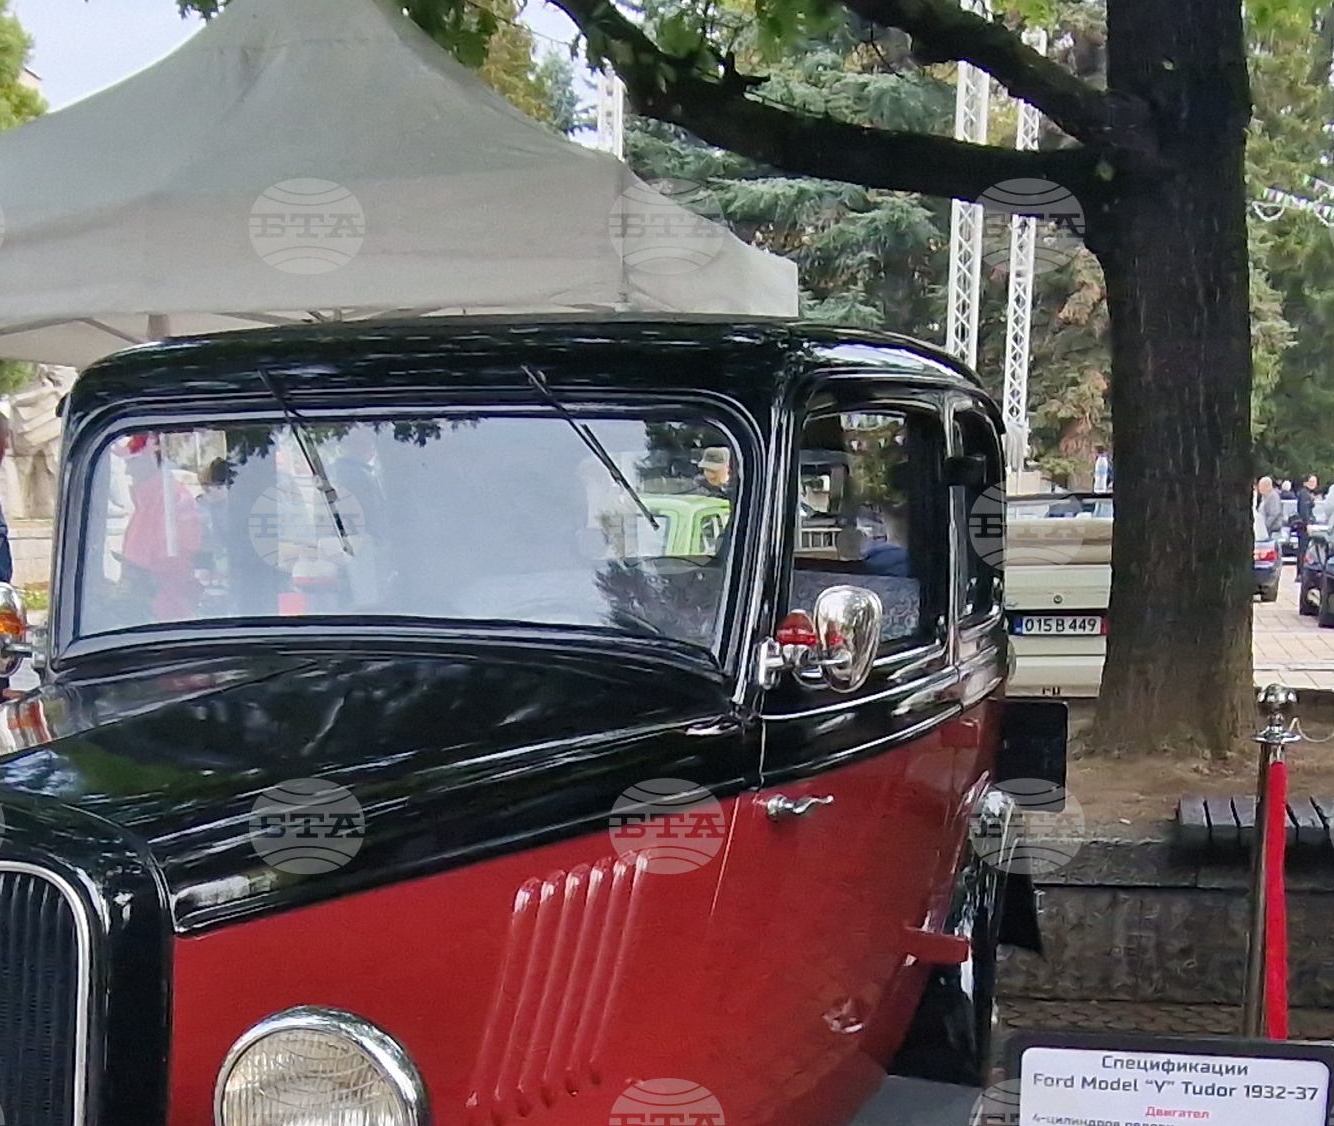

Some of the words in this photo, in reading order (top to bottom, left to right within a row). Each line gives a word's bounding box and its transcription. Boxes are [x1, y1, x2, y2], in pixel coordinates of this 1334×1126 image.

[1055, 619, 1065, 632] B
[1069, 618, 1097, 632] 449
[1102, 1055, 1248, 1076] Спецификации
[1033, 1073, 1075, 1088] Ford
[1081, 1076, 1138, 1092] Model
[1181, 1081, 1237, 1097] Tudor
[1243, 1085, 1319, 1101] 1932-37
[1145, 1106, 1210, 1119] Двигател
